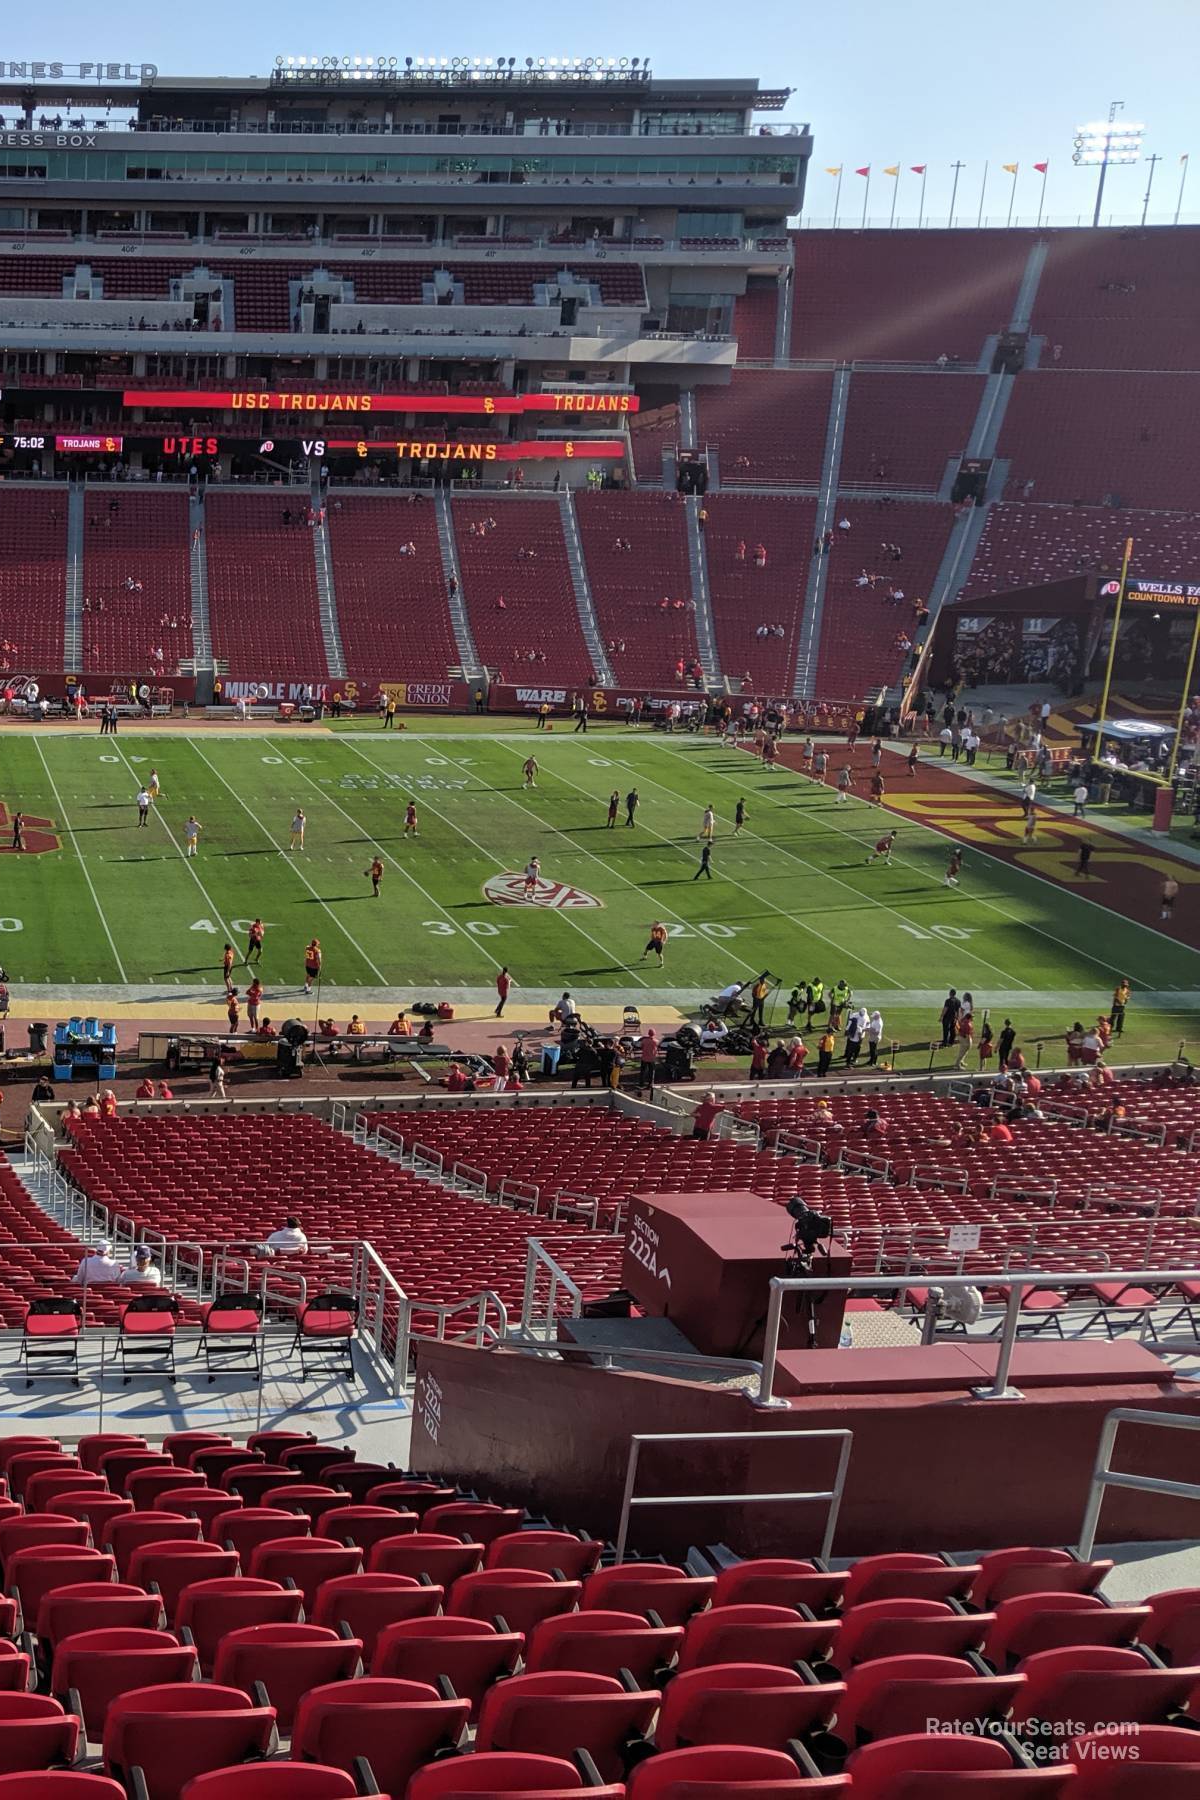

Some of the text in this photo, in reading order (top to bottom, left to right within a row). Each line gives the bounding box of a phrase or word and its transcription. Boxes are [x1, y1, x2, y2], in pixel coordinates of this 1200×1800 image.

[80, 62, 158, 81] FIELD
[56, 134, 97, 147] BOX
[232, 393, 371, 410] USC TROJANS
[554, 396, 629, 411] TROJANS
[14, 437, 45, 449] 75:02
[62, 439, 100, 448] TROJANS
[164, 438, 218, 455] UTES
[302, 441, 325, 456] VS
[397, 443, 496, 460] TROJANS
[1138, 582, 1183, 594] WELLS
[1128, 592, 1199, 606] COUNTDOWN TO
[960, 618, 979, 631] 34
[1028, 618, 1042, 632] 11
[407, 684, 454, 694] CREDIT
[515, 689, 567, 703] WARE
[407, 694, 451, 704] UNION
[421, 920, 501, 937] 30
[661, 922, 736, 939] 20
[897, 924, 971, 940] 10
[633, 1214, 660, 1248] SECTION
[628, 1230, 657, 1277] 222A
